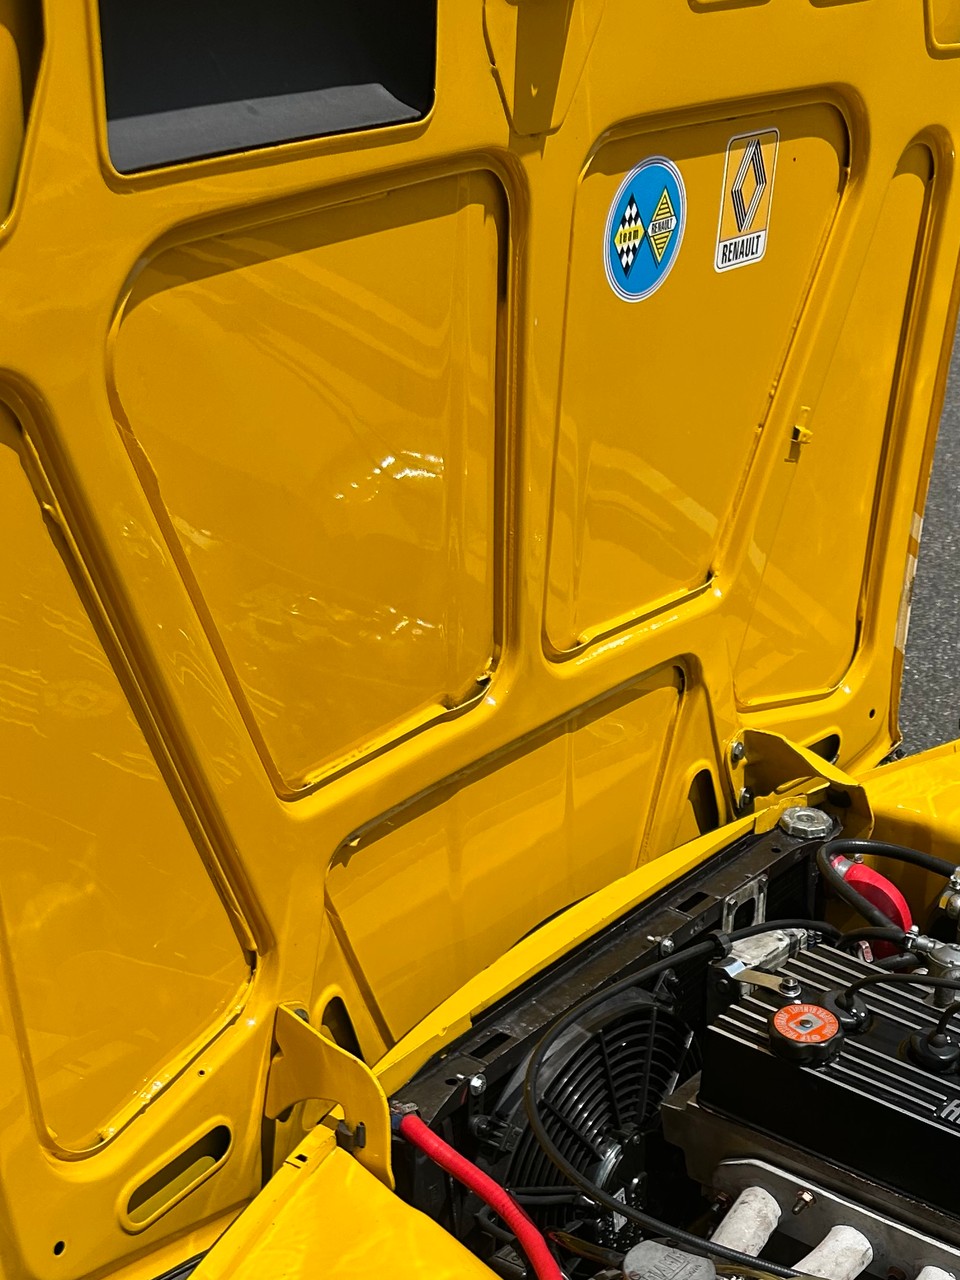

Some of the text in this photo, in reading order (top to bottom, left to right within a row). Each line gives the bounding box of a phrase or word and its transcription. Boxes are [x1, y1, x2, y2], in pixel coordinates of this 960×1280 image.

[651, 217, 673, 235] RENAULT
[620, 229, 639, 244] team
[721, 234, 761, 264] RENAULT
